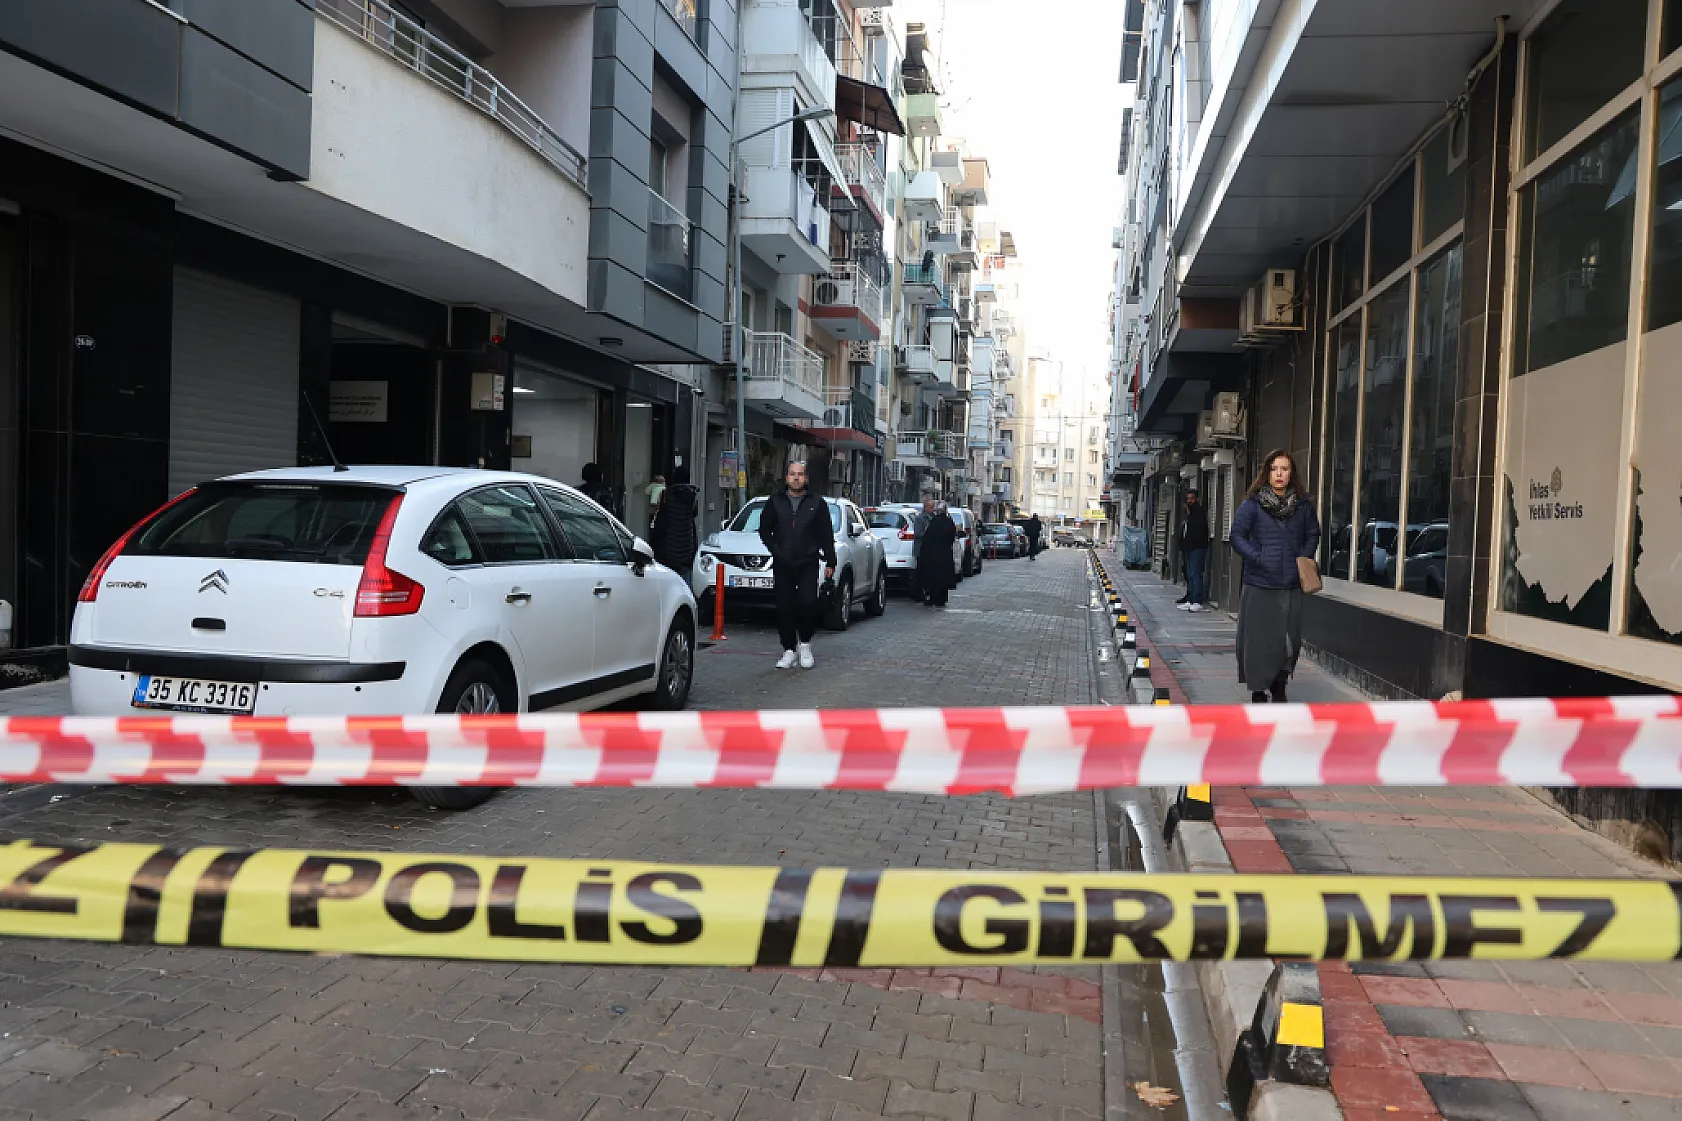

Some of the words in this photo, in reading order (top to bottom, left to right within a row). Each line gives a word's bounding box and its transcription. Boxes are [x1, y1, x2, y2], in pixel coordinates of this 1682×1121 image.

[1554, 500, 1583, 519] Servis
[313, 587, 345, 598] C4
[149, 679, 172, 700] 35
[177, 681, 201, 703] KC
[204, 683, 249, 707] 3316
[289, 855, 704, 944] POLİS
